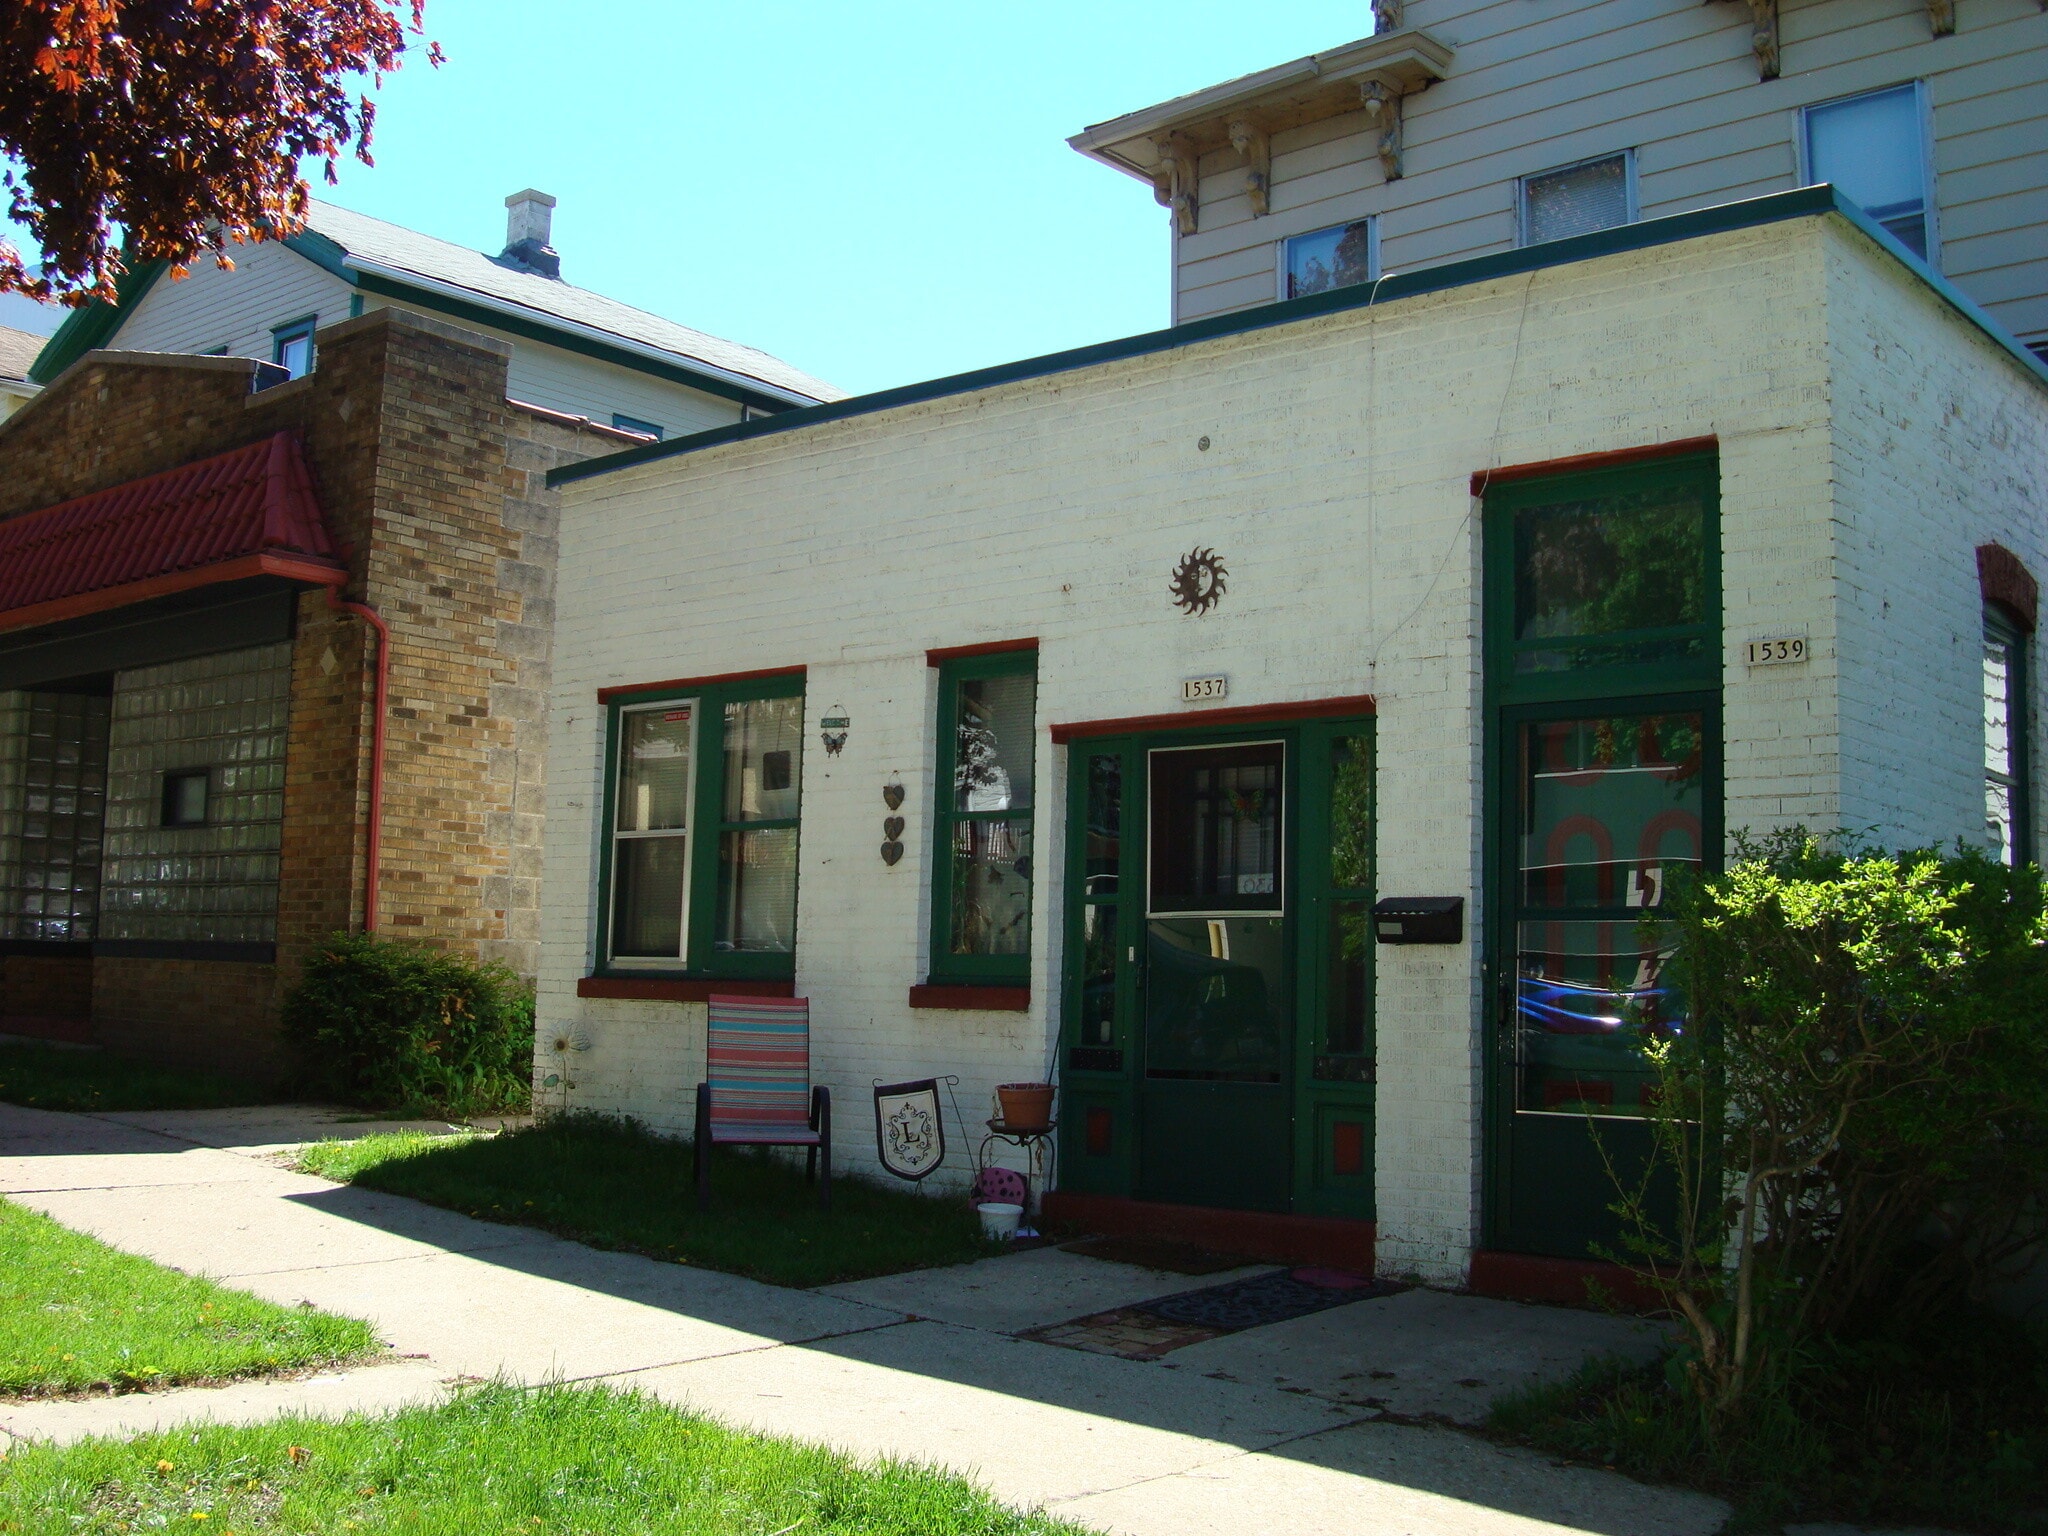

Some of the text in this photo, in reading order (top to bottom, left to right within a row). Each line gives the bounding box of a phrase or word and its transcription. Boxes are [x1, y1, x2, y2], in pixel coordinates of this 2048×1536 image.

[1749, 640, 1803, 662] 1539
[1185, 679, 1223, 698] 1537
[900, 1121, 921, 1144] L
